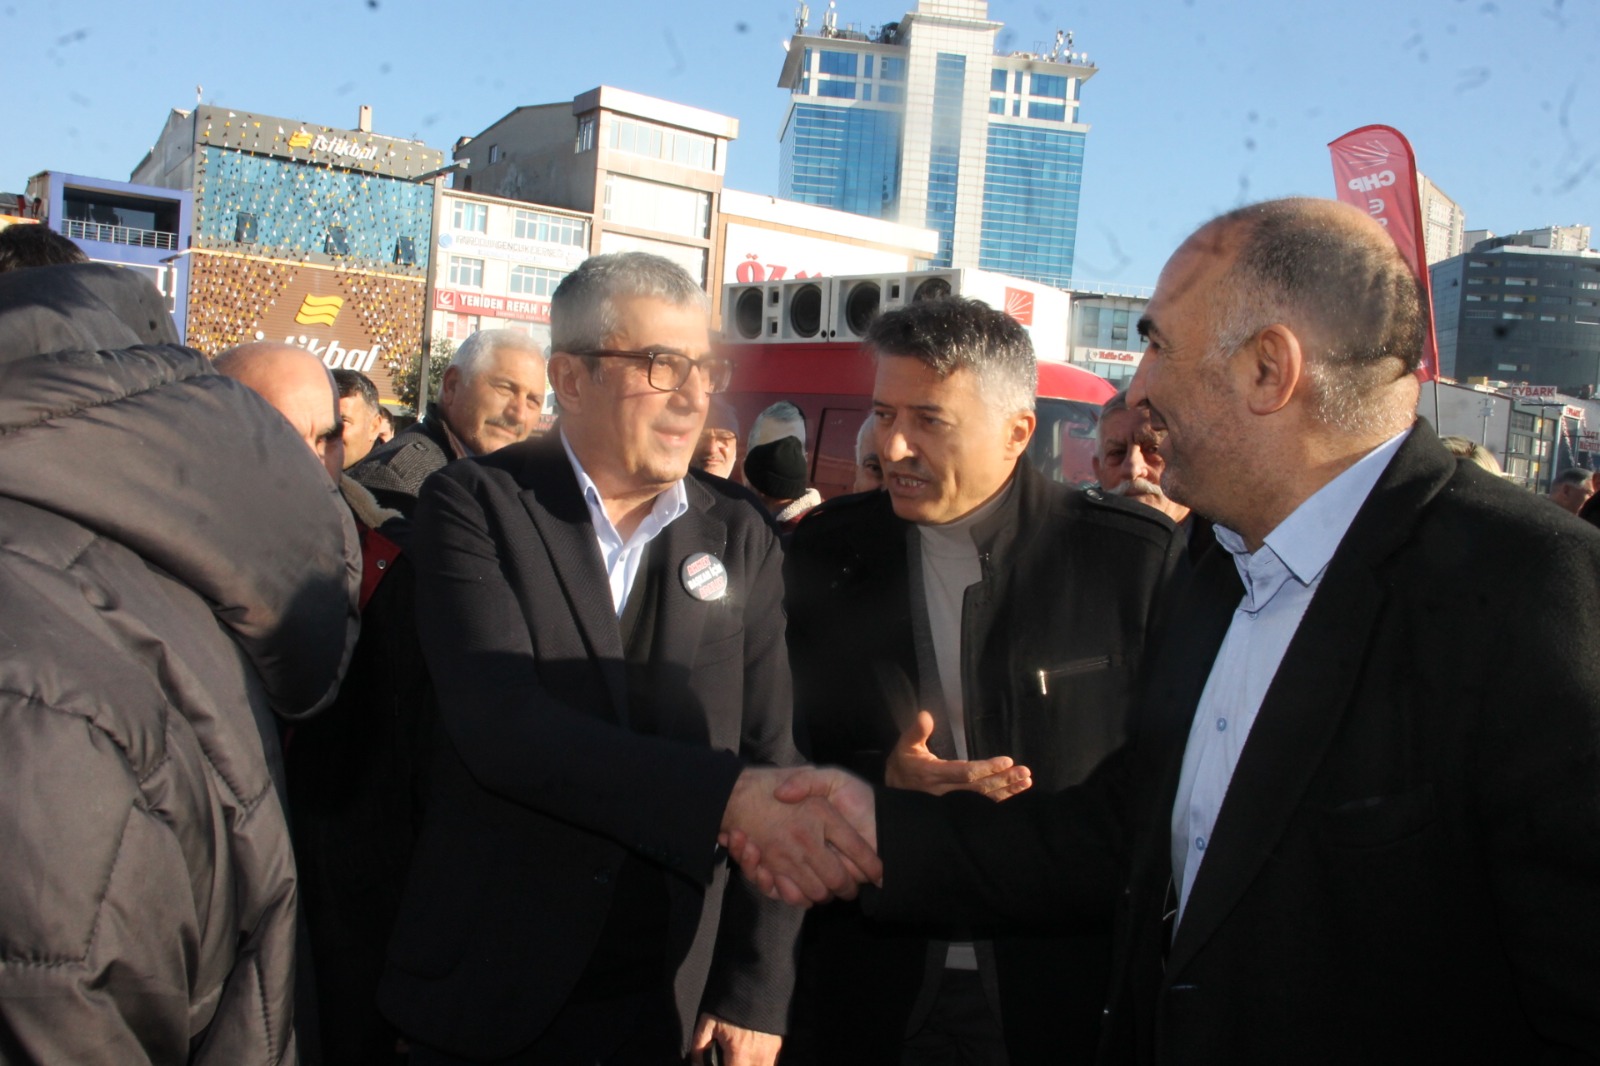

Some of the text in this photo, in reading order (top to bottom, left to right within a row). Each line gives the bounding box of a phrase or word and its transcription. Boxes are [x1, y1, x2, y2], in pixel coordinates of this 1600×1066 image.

[736, 253, 823, 284] ÖZ
[459, 294, 503, 310] YENİDEN
[506, 301, 537, 314] REFAH
[687, 555, 711, 576] AHMET
